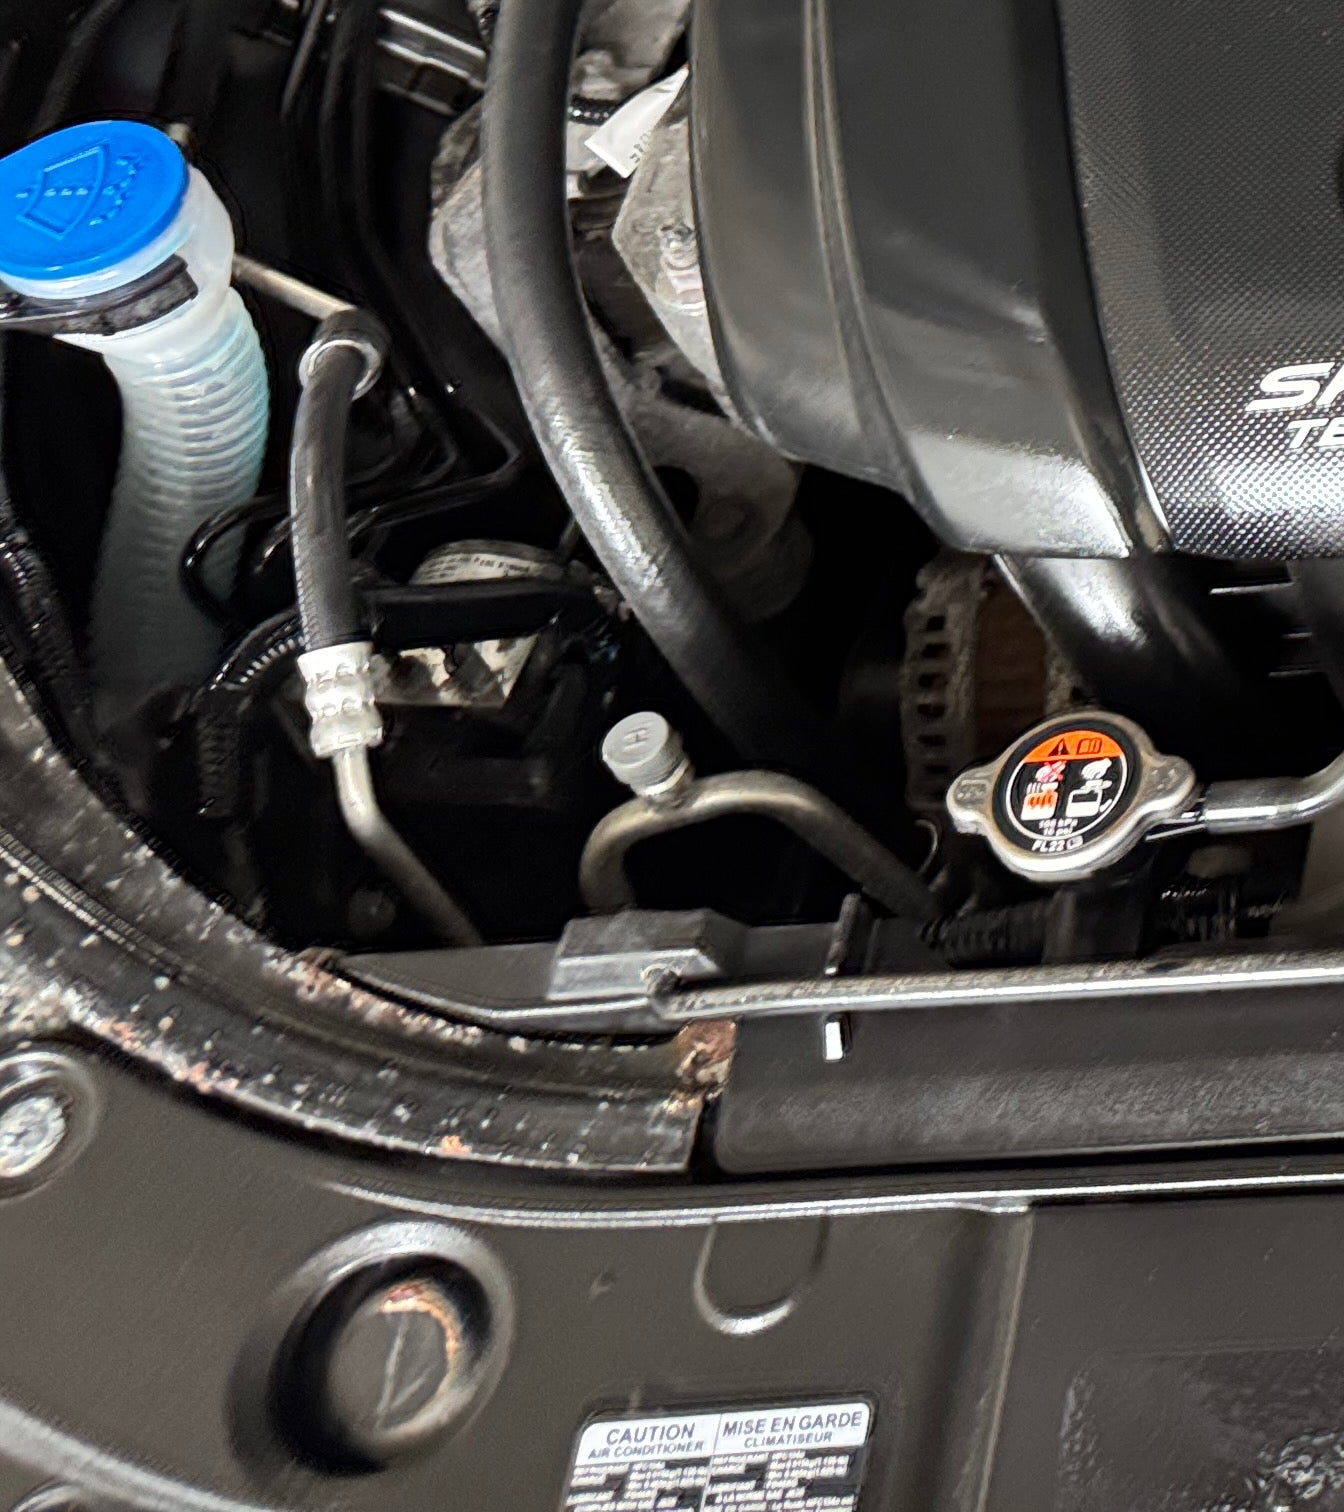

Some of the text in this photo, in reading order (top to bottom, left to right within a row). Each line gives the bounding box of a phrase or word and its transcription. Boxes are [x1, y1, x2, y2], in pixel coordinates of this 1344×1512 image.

[606, 1422, 696, 1445] CAUTION
[722, 1411, 862, 1437] MISE EN GARDE
[588, 1440, 704, 1459] AIR CONDITIONER
